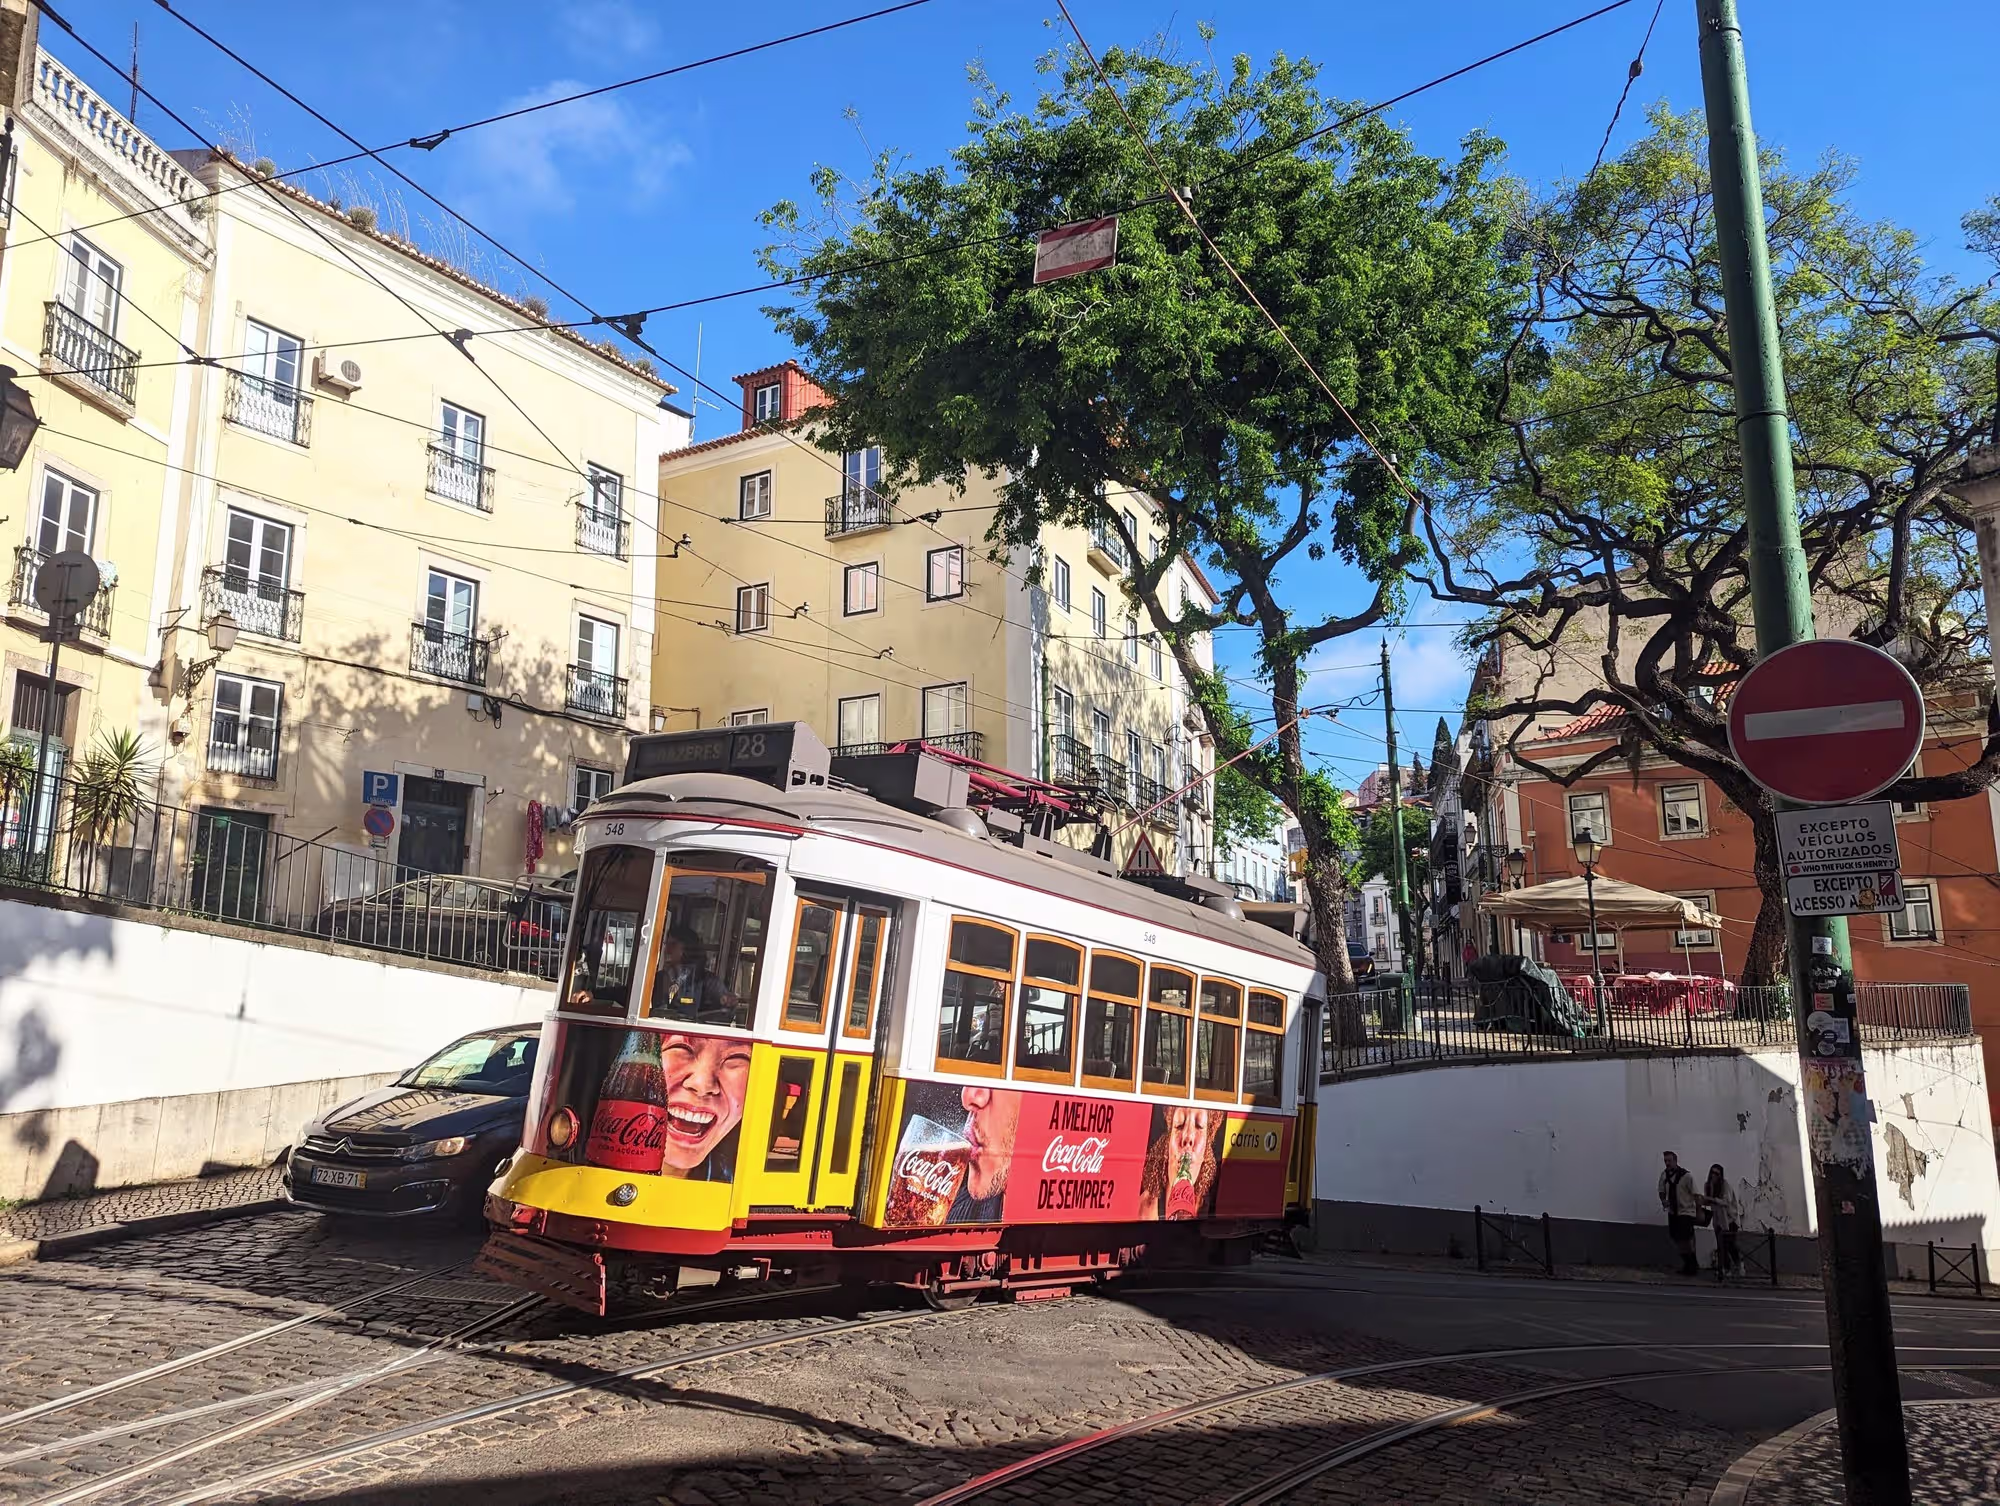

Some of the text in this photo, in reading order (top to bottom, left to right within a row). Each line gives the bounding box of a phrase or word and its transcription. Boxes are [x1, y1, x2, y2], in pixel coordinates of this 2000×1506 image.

[735, 733, 766, 760] 28
[373, 775, 388, 796] P
[604, 822, 625, 836] 548
[1800, 818, 1870, 833] EXCEPTO
[1797, 831, 1877, 847] VEÍCULOS
[1787, 843, 1893, 861] AUTORIZADOS
[1802, 864, 1820, 873] WHO
[1821, 863, 1835, 871] THE
[1836, 862, 1854, 870] FUCK
[1855, 861, 1863, 869] IS
[1813, 876, 1873, 892] EXCEPTO
[1794, 895, 1845, 911] ACESSO
[1144, 931, 1156, 944] 548
[1049, 1100, 1114, 1133] A MELHOR
[1230, 1129, 1260, 1148] carris
[1037, 1179, 1114, 1210] DE SEMPRE?
